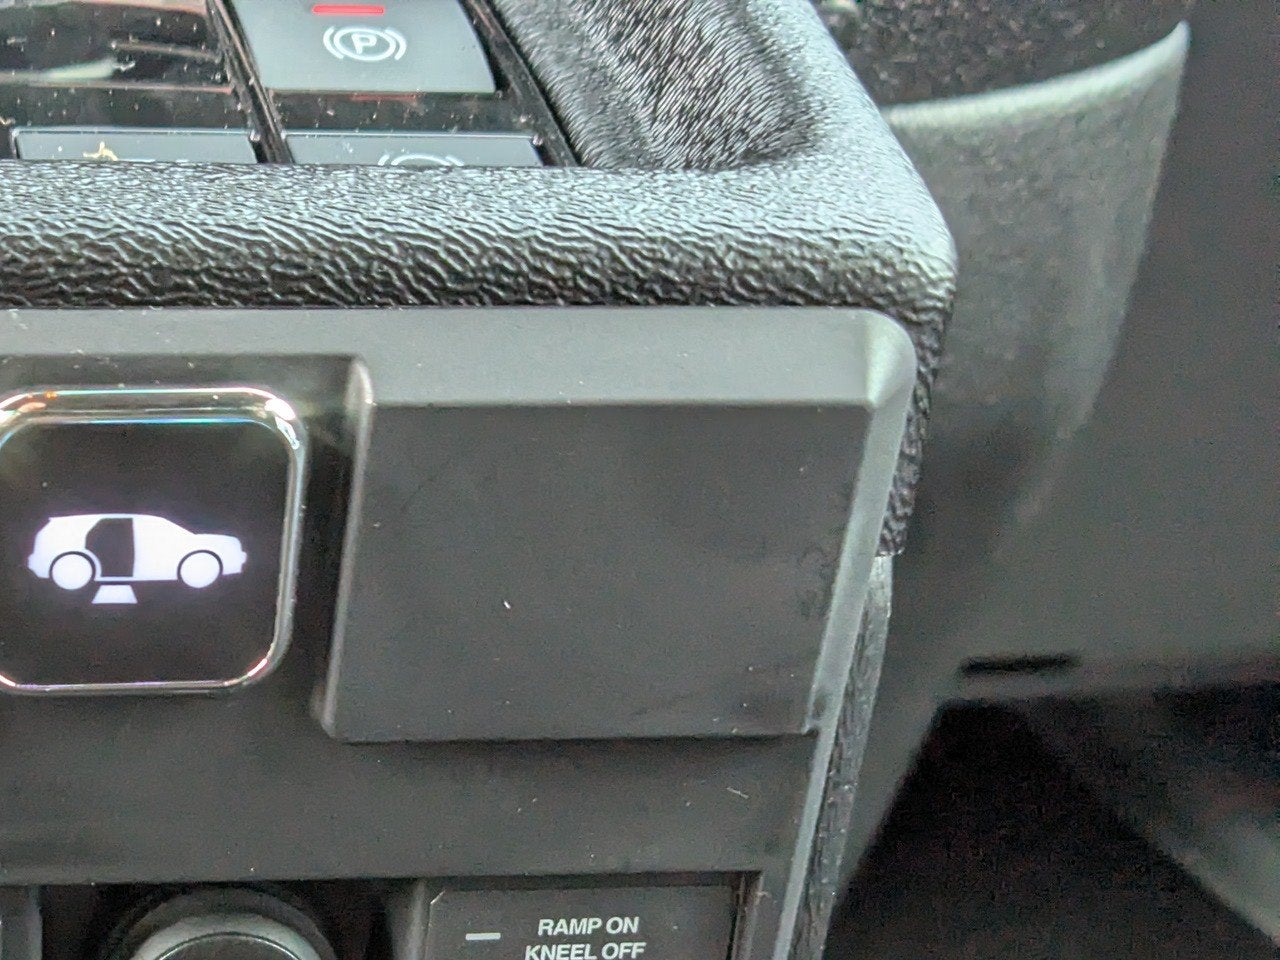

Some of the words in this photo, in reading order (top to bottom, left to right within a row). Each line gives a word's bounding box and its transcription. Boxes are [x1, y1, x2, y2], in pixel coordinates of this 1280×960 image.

[538, 918, 601, 936] RAMP
[606, 916, 640, 934] ON
[601, 942, 646, 960] OFF
